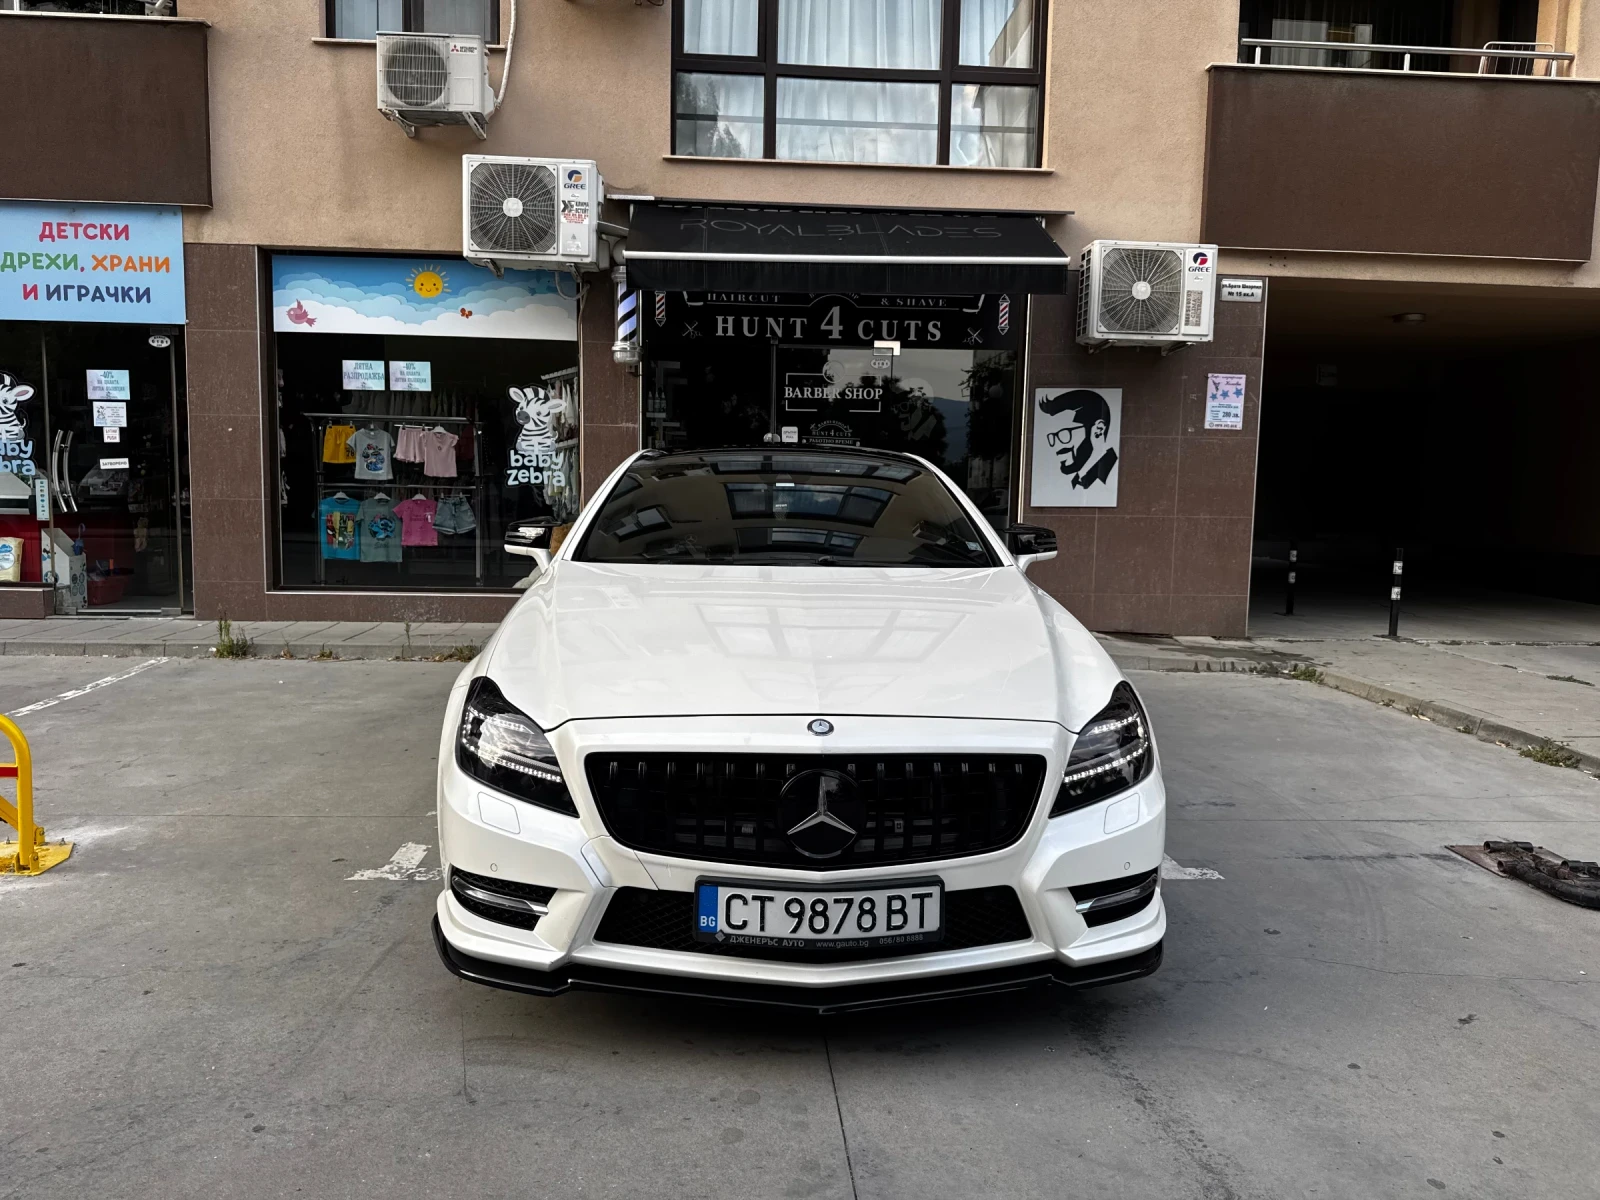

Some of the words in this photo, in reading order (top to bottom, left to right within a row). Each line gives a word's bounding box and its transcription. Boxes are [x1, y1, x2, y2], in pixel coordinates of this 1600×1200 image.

[39, 221, 130, 242] ДЕТСКИ
[0, 252, 85, 273] ДРЕХИ,
[91, 254, 170, 273] ХРАНИ
[22, 283, 38, 301] И
[46, 283, 151, 304] ИГРАЧКИ
[707, 292, 781, 303] HAIRCUT
[880, 298, 890, 306] &
[896, 298, 947, 307] SHAVE
[715, 316, 808, 338] HUNT
[820, 306, 844, 339] 4
[857, 319, 942, 341] CUTS
[343, 371, 385, 381] РАЗПРОДАЖБА
[784, 386, 841, 399] BARBER
[845, 387, 884, 400] SHOP
[509, 449, 564, 470] baby
[506, 466, 566, 486] zebra
[700, 915, 716, 927] BG
[724, 892, 775, 931] CT
[783, 896, 877, 935] 9878
[886, 891, 934, 932] BT
[729, 935, 779, 947] ДЖЕНЕРЪС
[782, 938, 805, 947] АУТО
[816, 939, 869, 948] www.gauto.bg
[879, 935, 905, 945] 056/80
[906, 933, 924, 942] 8888
